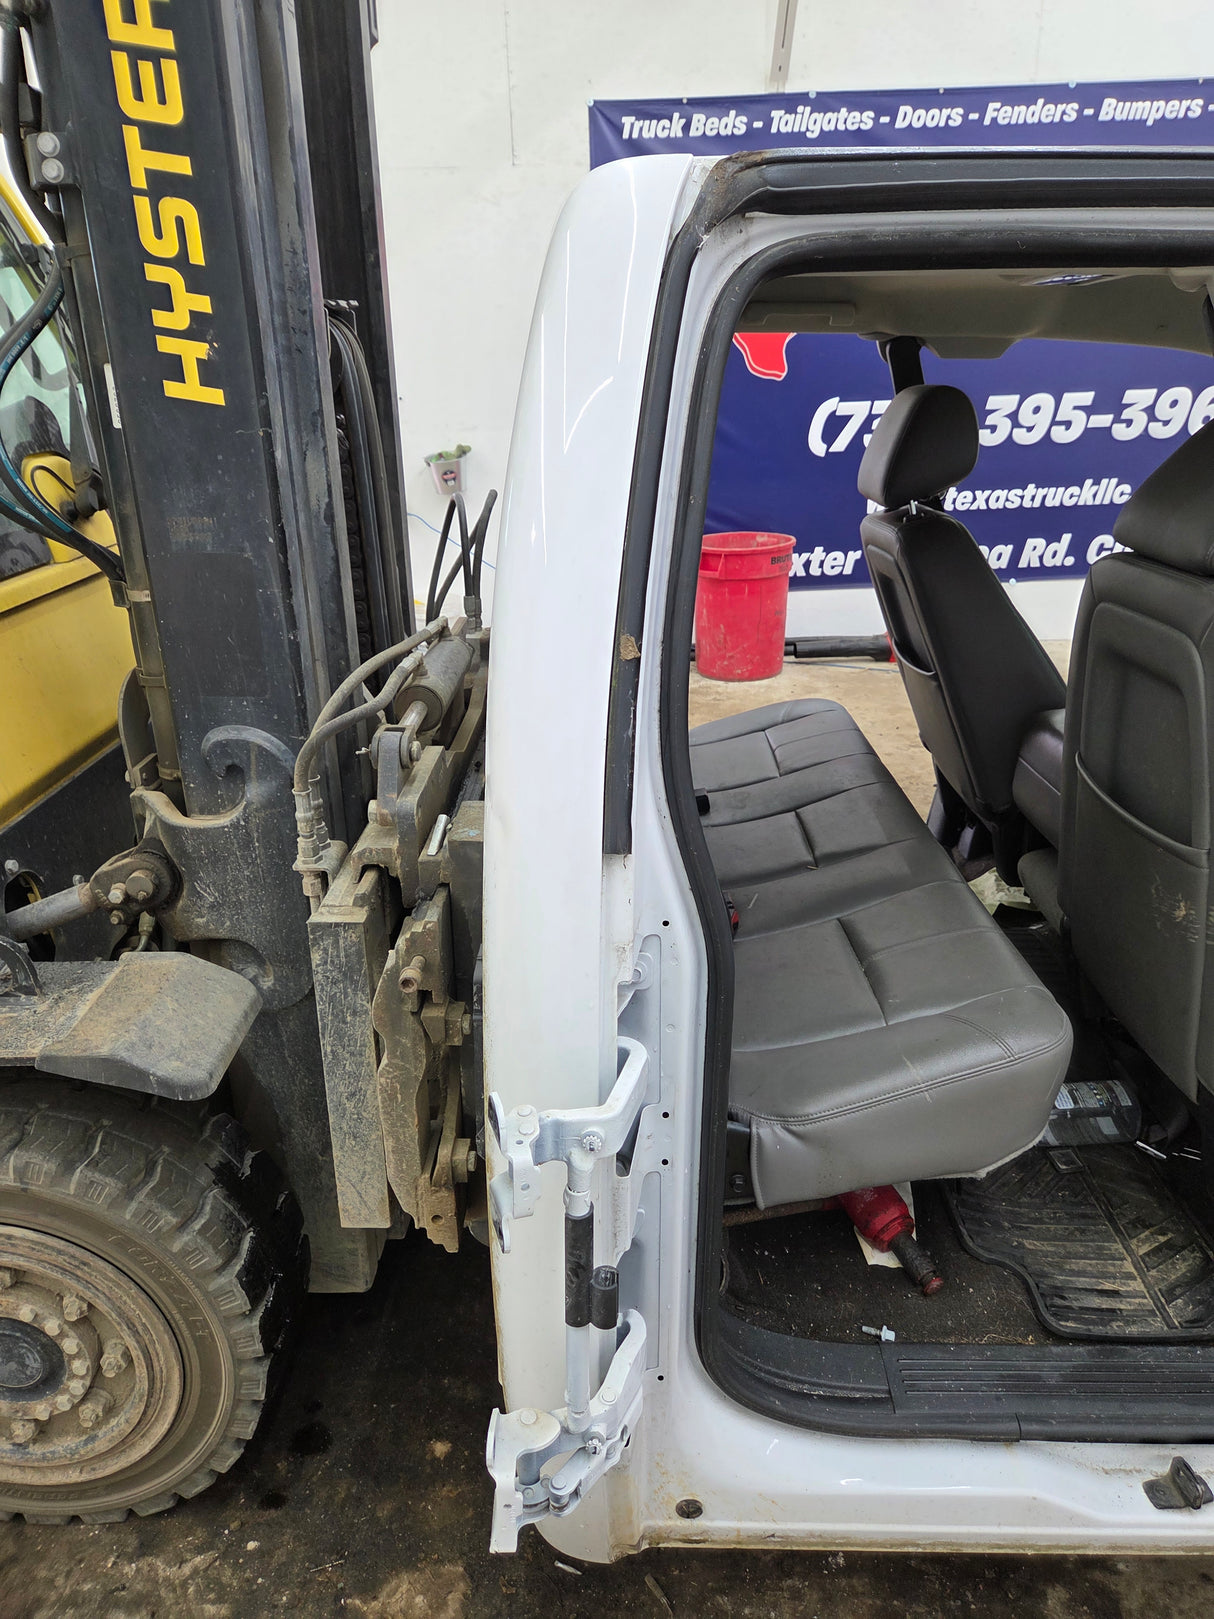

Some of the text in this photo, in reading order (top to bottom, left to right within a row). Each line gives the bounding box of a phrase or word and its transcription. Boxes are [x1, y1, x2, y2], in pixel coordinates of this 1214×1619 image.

[621, 112, 687, 139] Truck
[689, 110, 748, 137] Beds
[770, 105, 875, 138] Tailgates
[895, 105, 964, 129] Doors
[983, 98, 1079, 126] Fenders
[1098, 97, 1205, 127] Bumpers
[1017, 532, 1076, 568] Rd.
